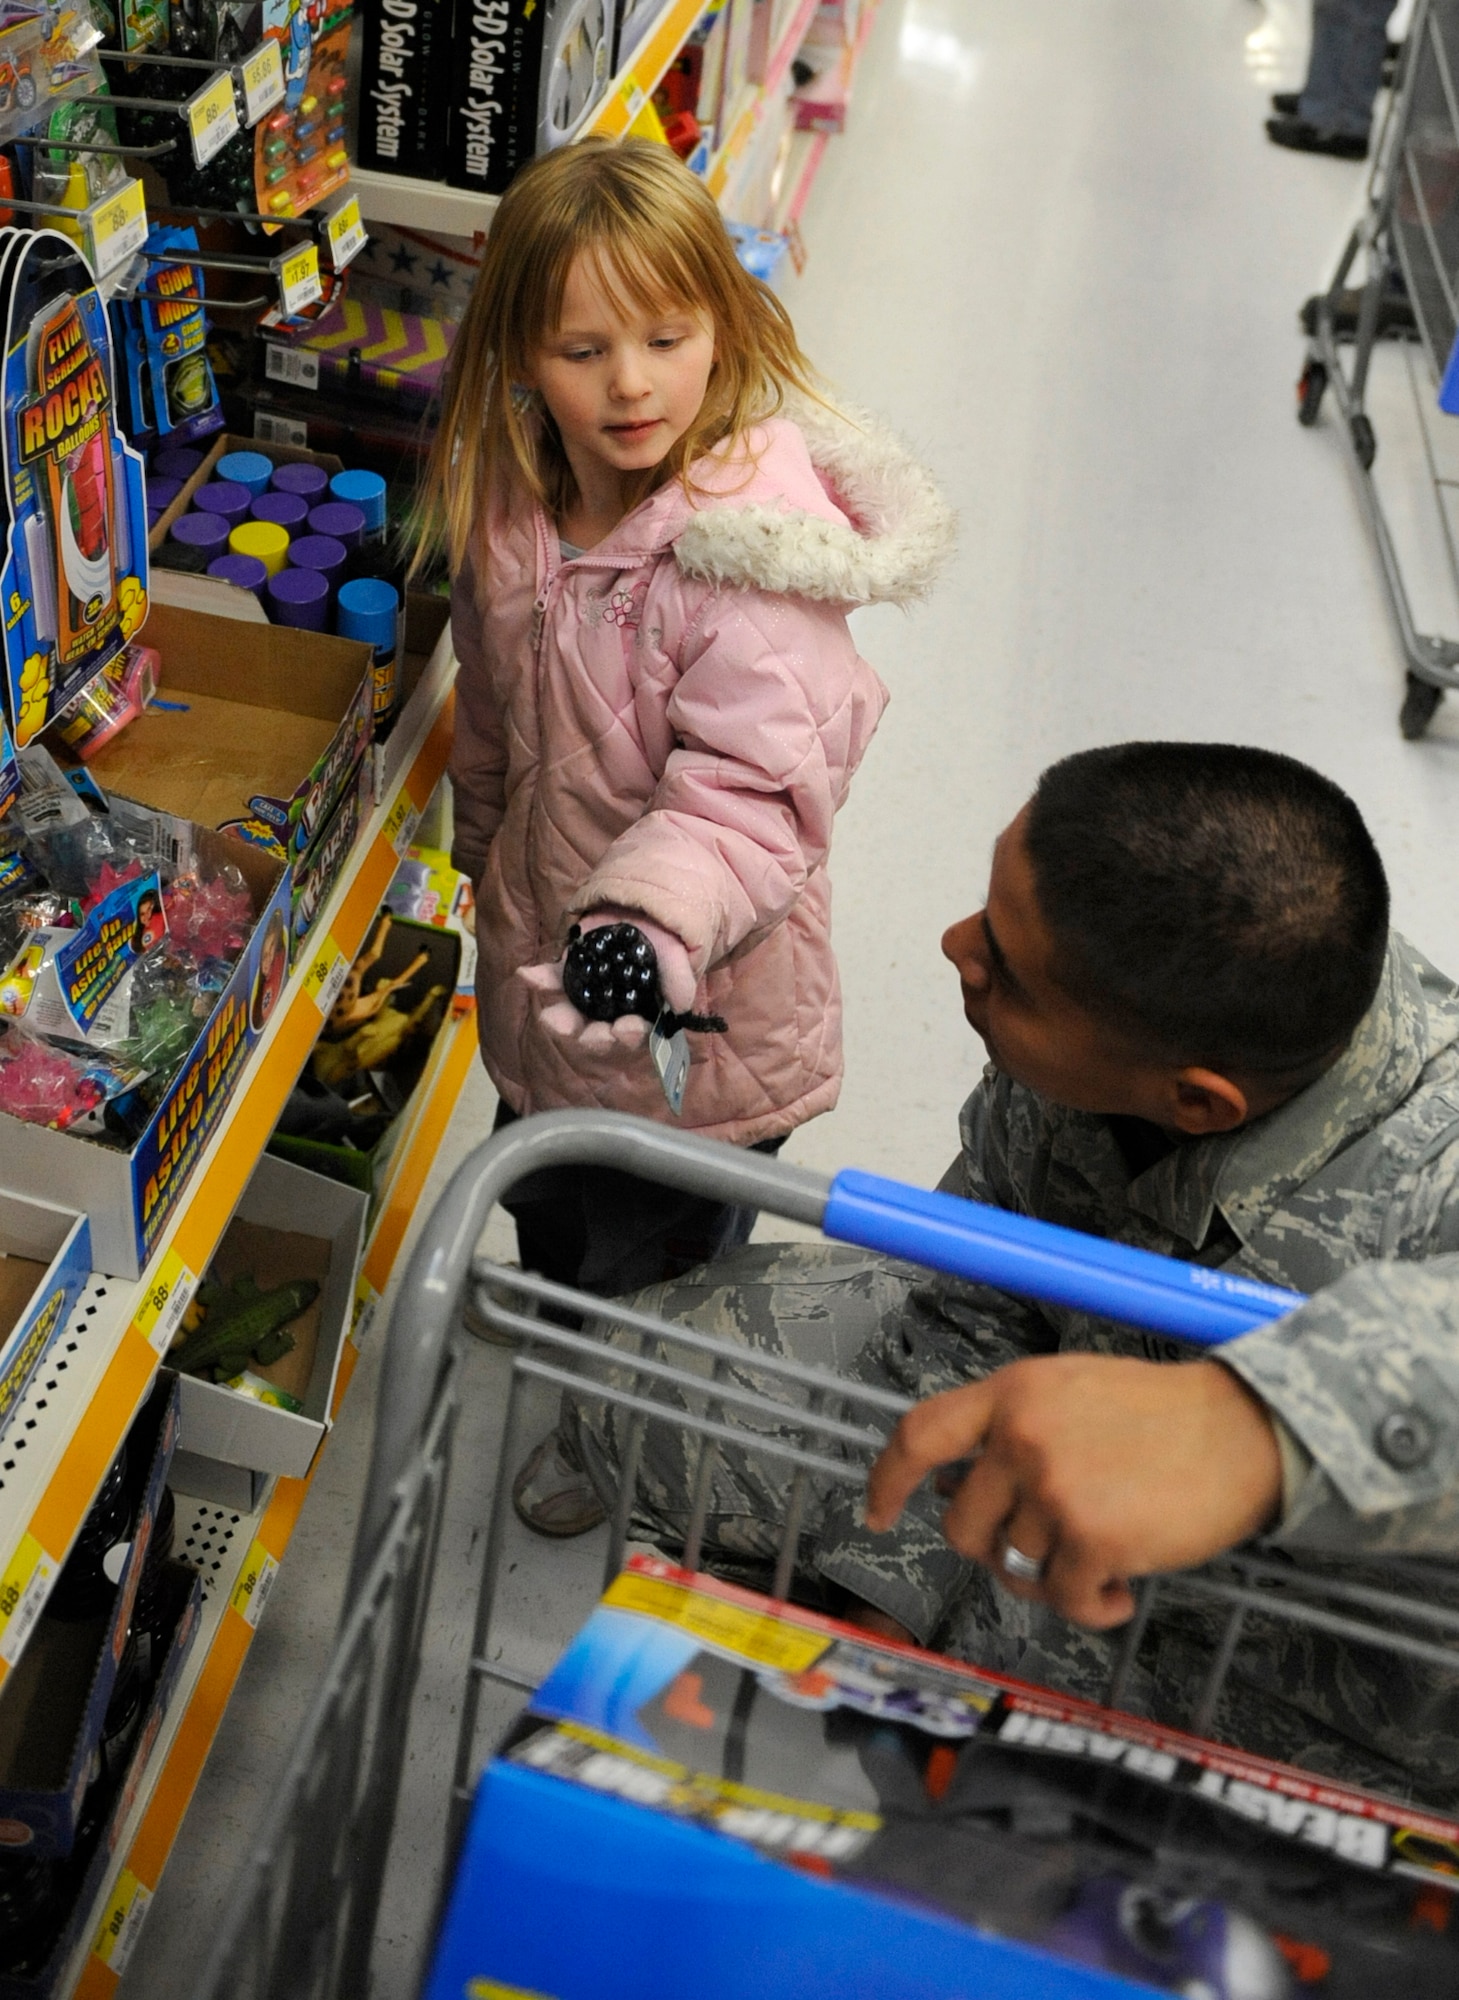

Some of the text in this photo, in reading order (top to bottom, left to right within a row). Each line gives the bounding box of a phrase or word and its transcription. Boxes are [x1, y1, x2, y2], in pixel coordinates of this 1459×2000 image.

[379, 19, 415, 78] Solar
[512, 26, 523, 74] GLOW
[459, 0, 509, 175] 3-D Solar System
[370, 79, 412, 158] System
[506, 124, 517, 168] DARK
[57, 414, 100, 458] BALLOONS
[9, 591, 21, 613] 6
[70, 956, 107, 1004] Astro
[74, 941, 103, 976] Lite
[143, 1000, 247, 1222] Astro Ball
[169, 1138, 198, 1197] Action
[1192, 1768, 1390, 1870] BEAST
